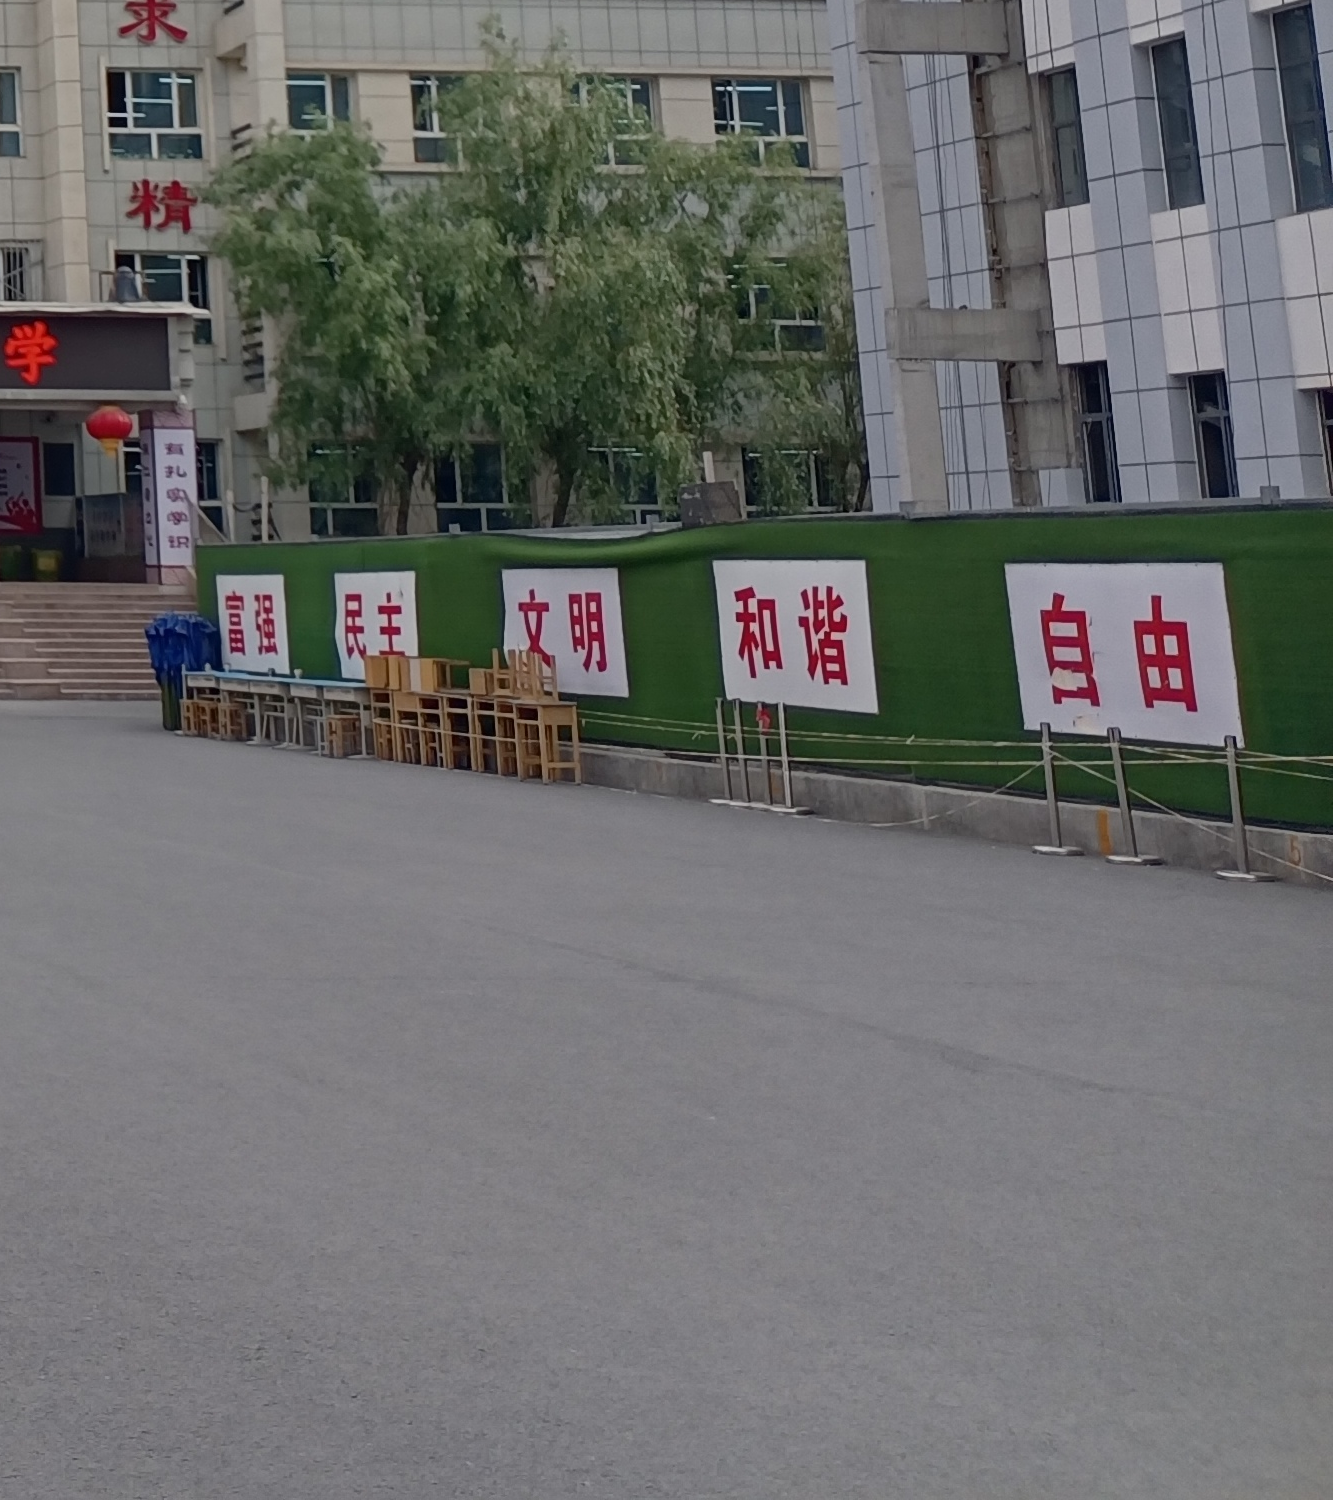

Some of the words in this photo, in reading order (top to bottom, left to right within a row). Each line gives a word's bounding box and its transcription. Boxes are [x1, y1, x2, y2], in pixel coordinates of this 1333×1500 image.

[224, 590, 279, 656] 富强
[344, 592, 405, 659] 民主
[518, 589, 609, 673] 文明
[734, 585, 849, 686] 和谐
[1040, 592, 1199, 713] 自由
